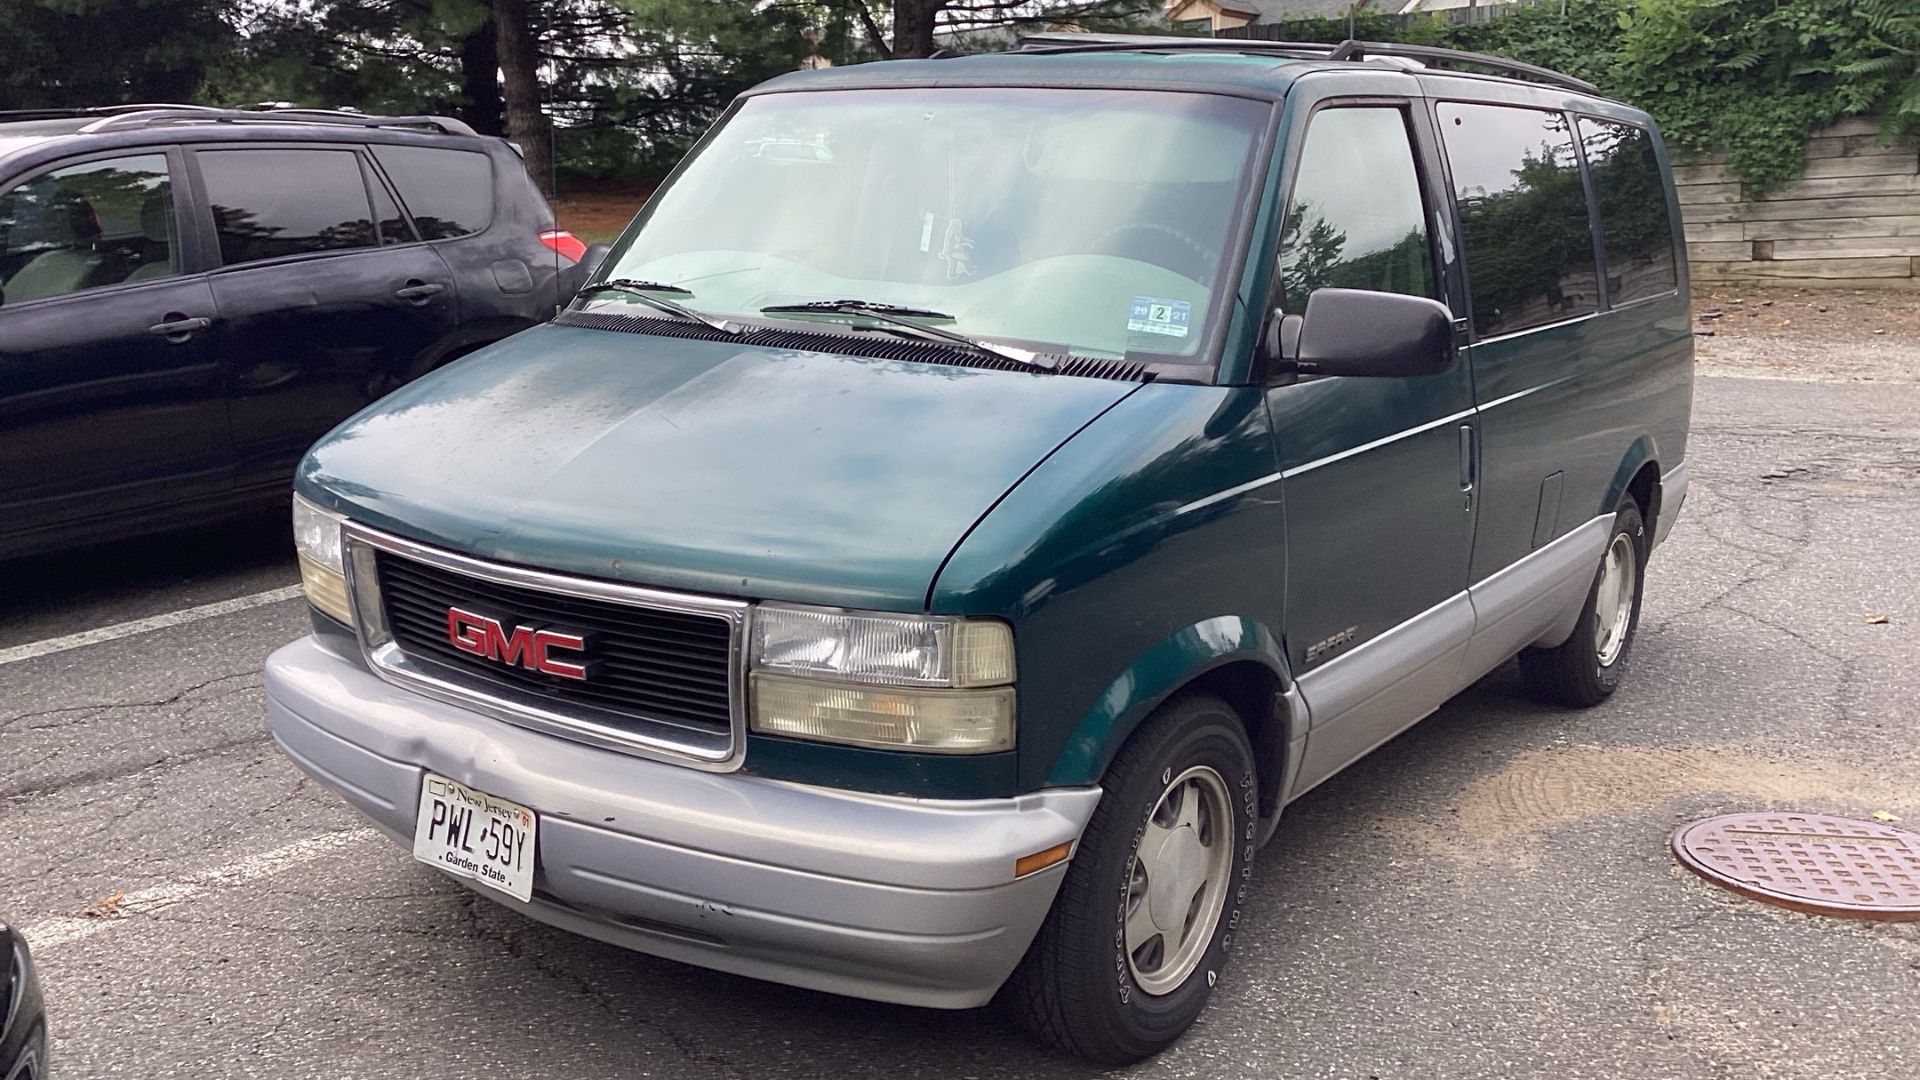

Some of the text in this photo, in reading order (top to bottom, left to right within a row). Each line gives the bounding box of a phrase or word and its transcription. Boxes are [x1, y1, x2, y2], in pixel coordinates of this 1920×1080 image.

[1134, 304, 1187, 321] 20 2 21
[448, 606, 587, 680] GMC
[456, 787, 514, 821] New Jersey
[428, 799, 526, 872] PWL 59Y
[445, 851, 506, 883] Garden State
